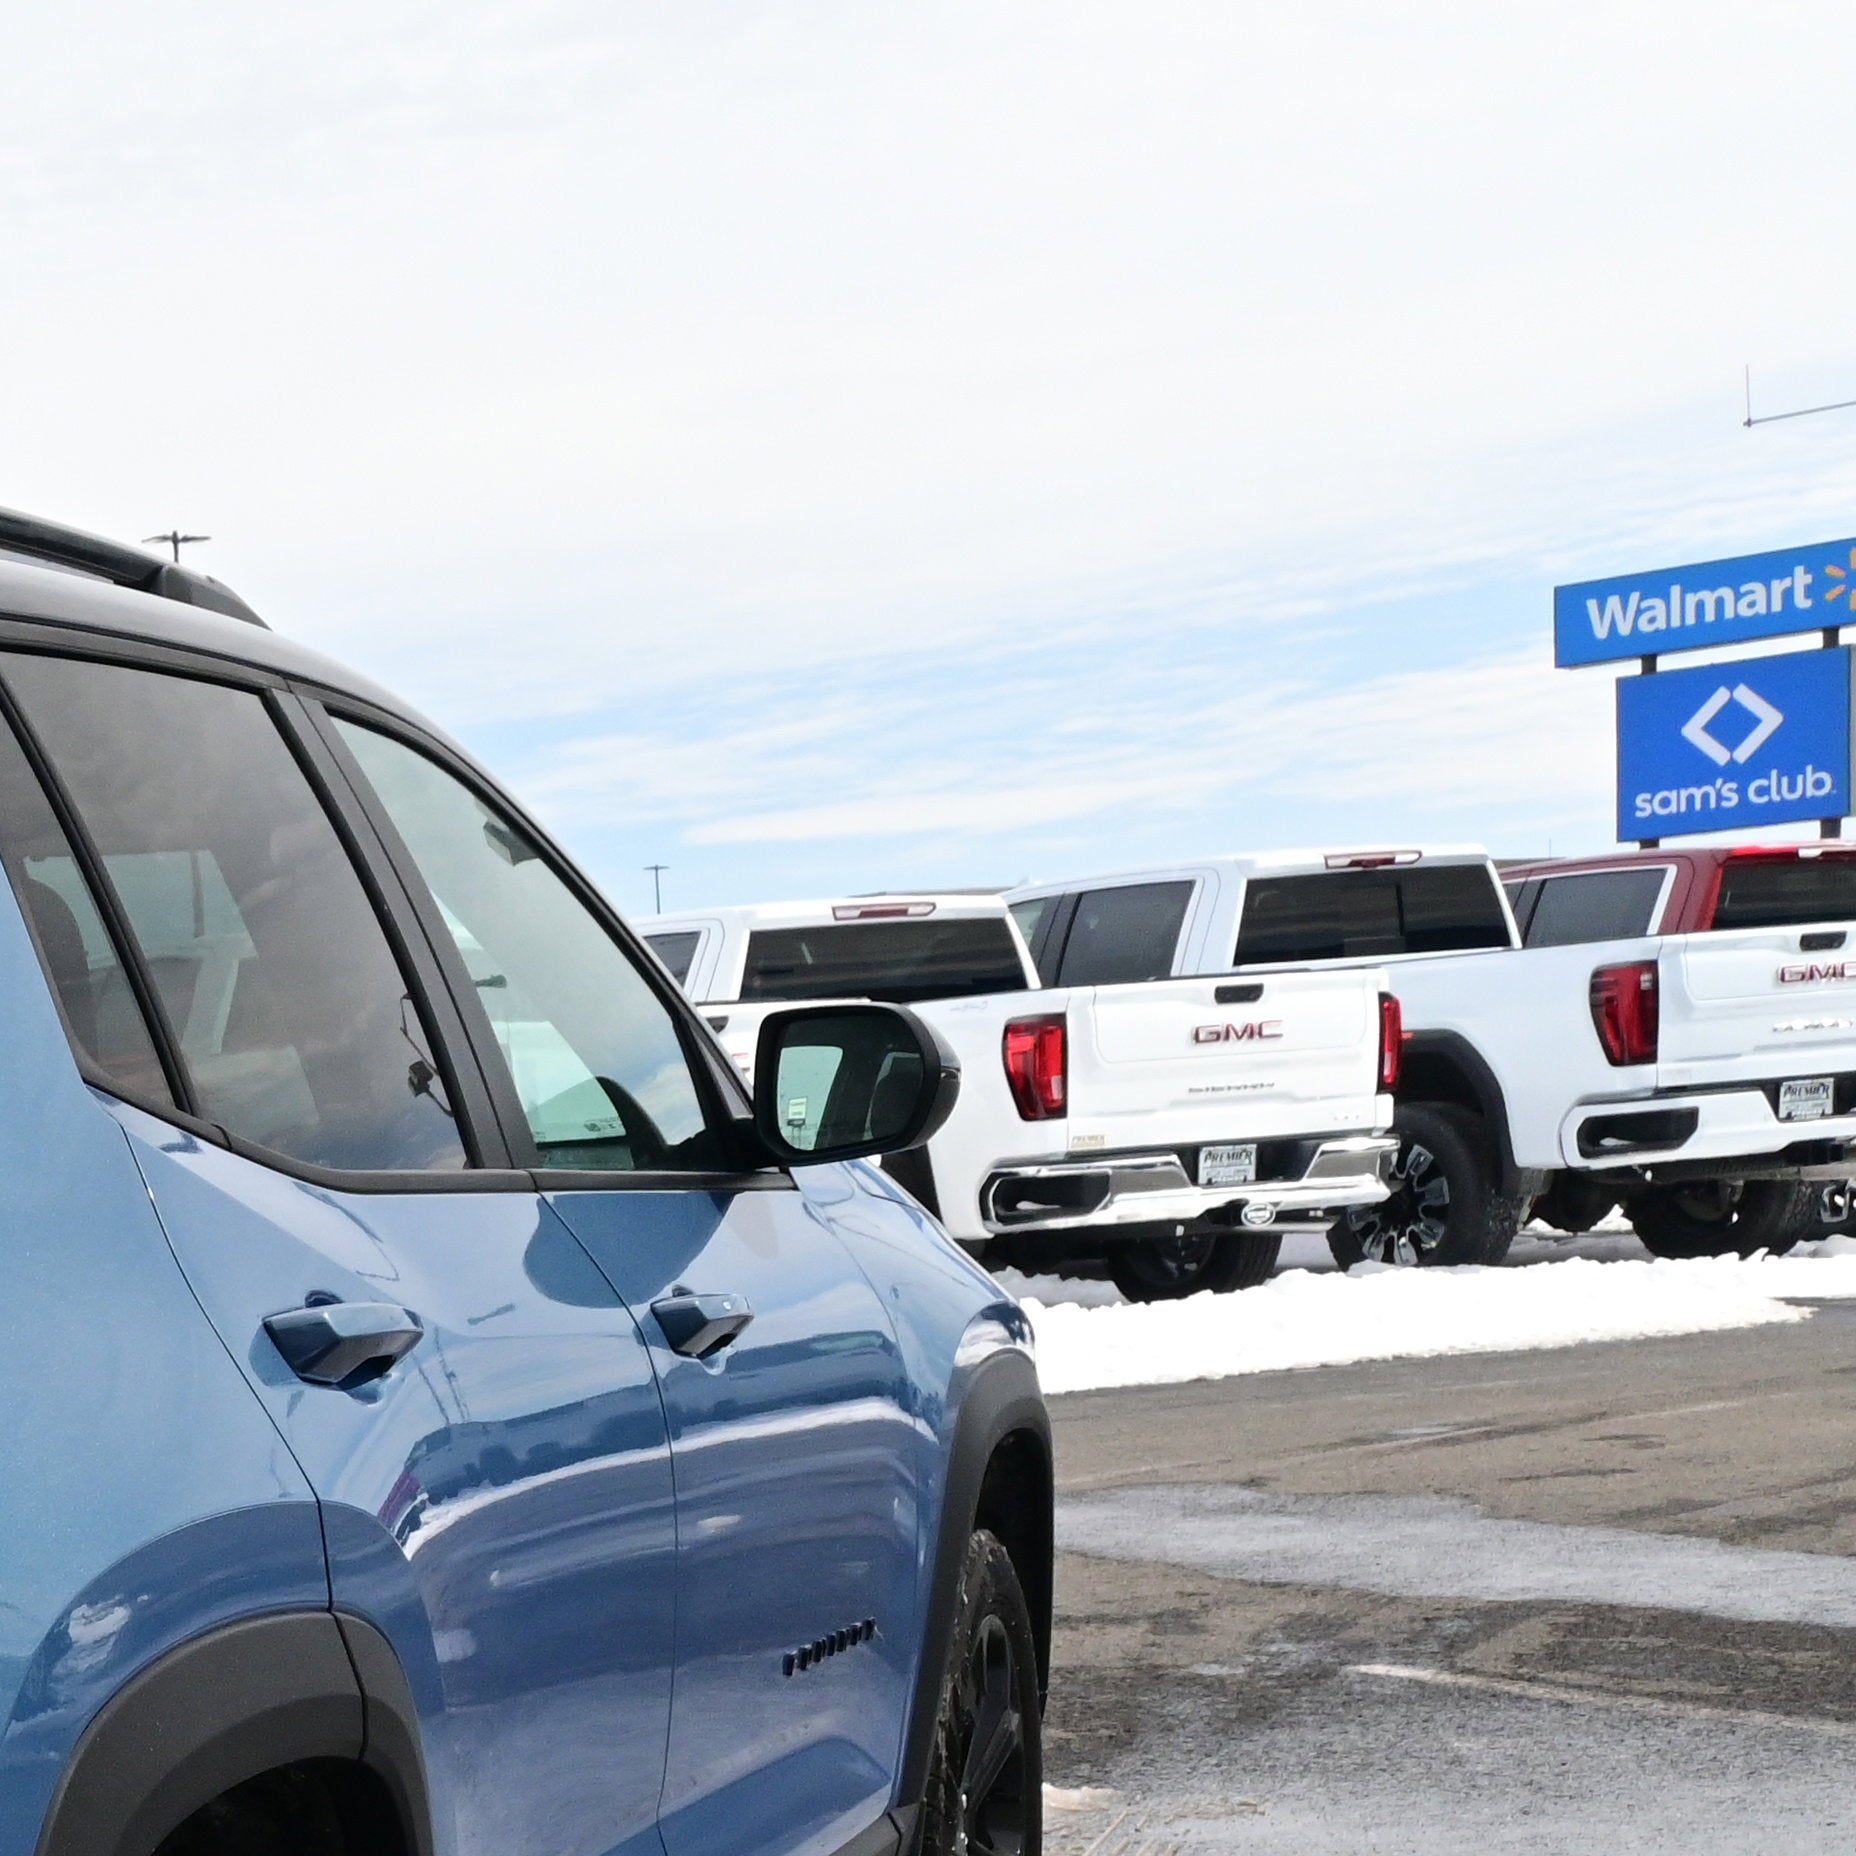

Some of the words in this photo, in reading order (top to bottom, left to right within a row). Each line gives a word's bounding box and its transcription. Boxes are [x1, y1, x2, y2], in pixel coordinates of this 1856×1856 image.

[1586, 565, 1813, 640] Walmart
[1635, 778, 1739, 818] sam's
[1747, 764, 1834, 804] club
[1193, 1019, 1284, 1044] GMC
